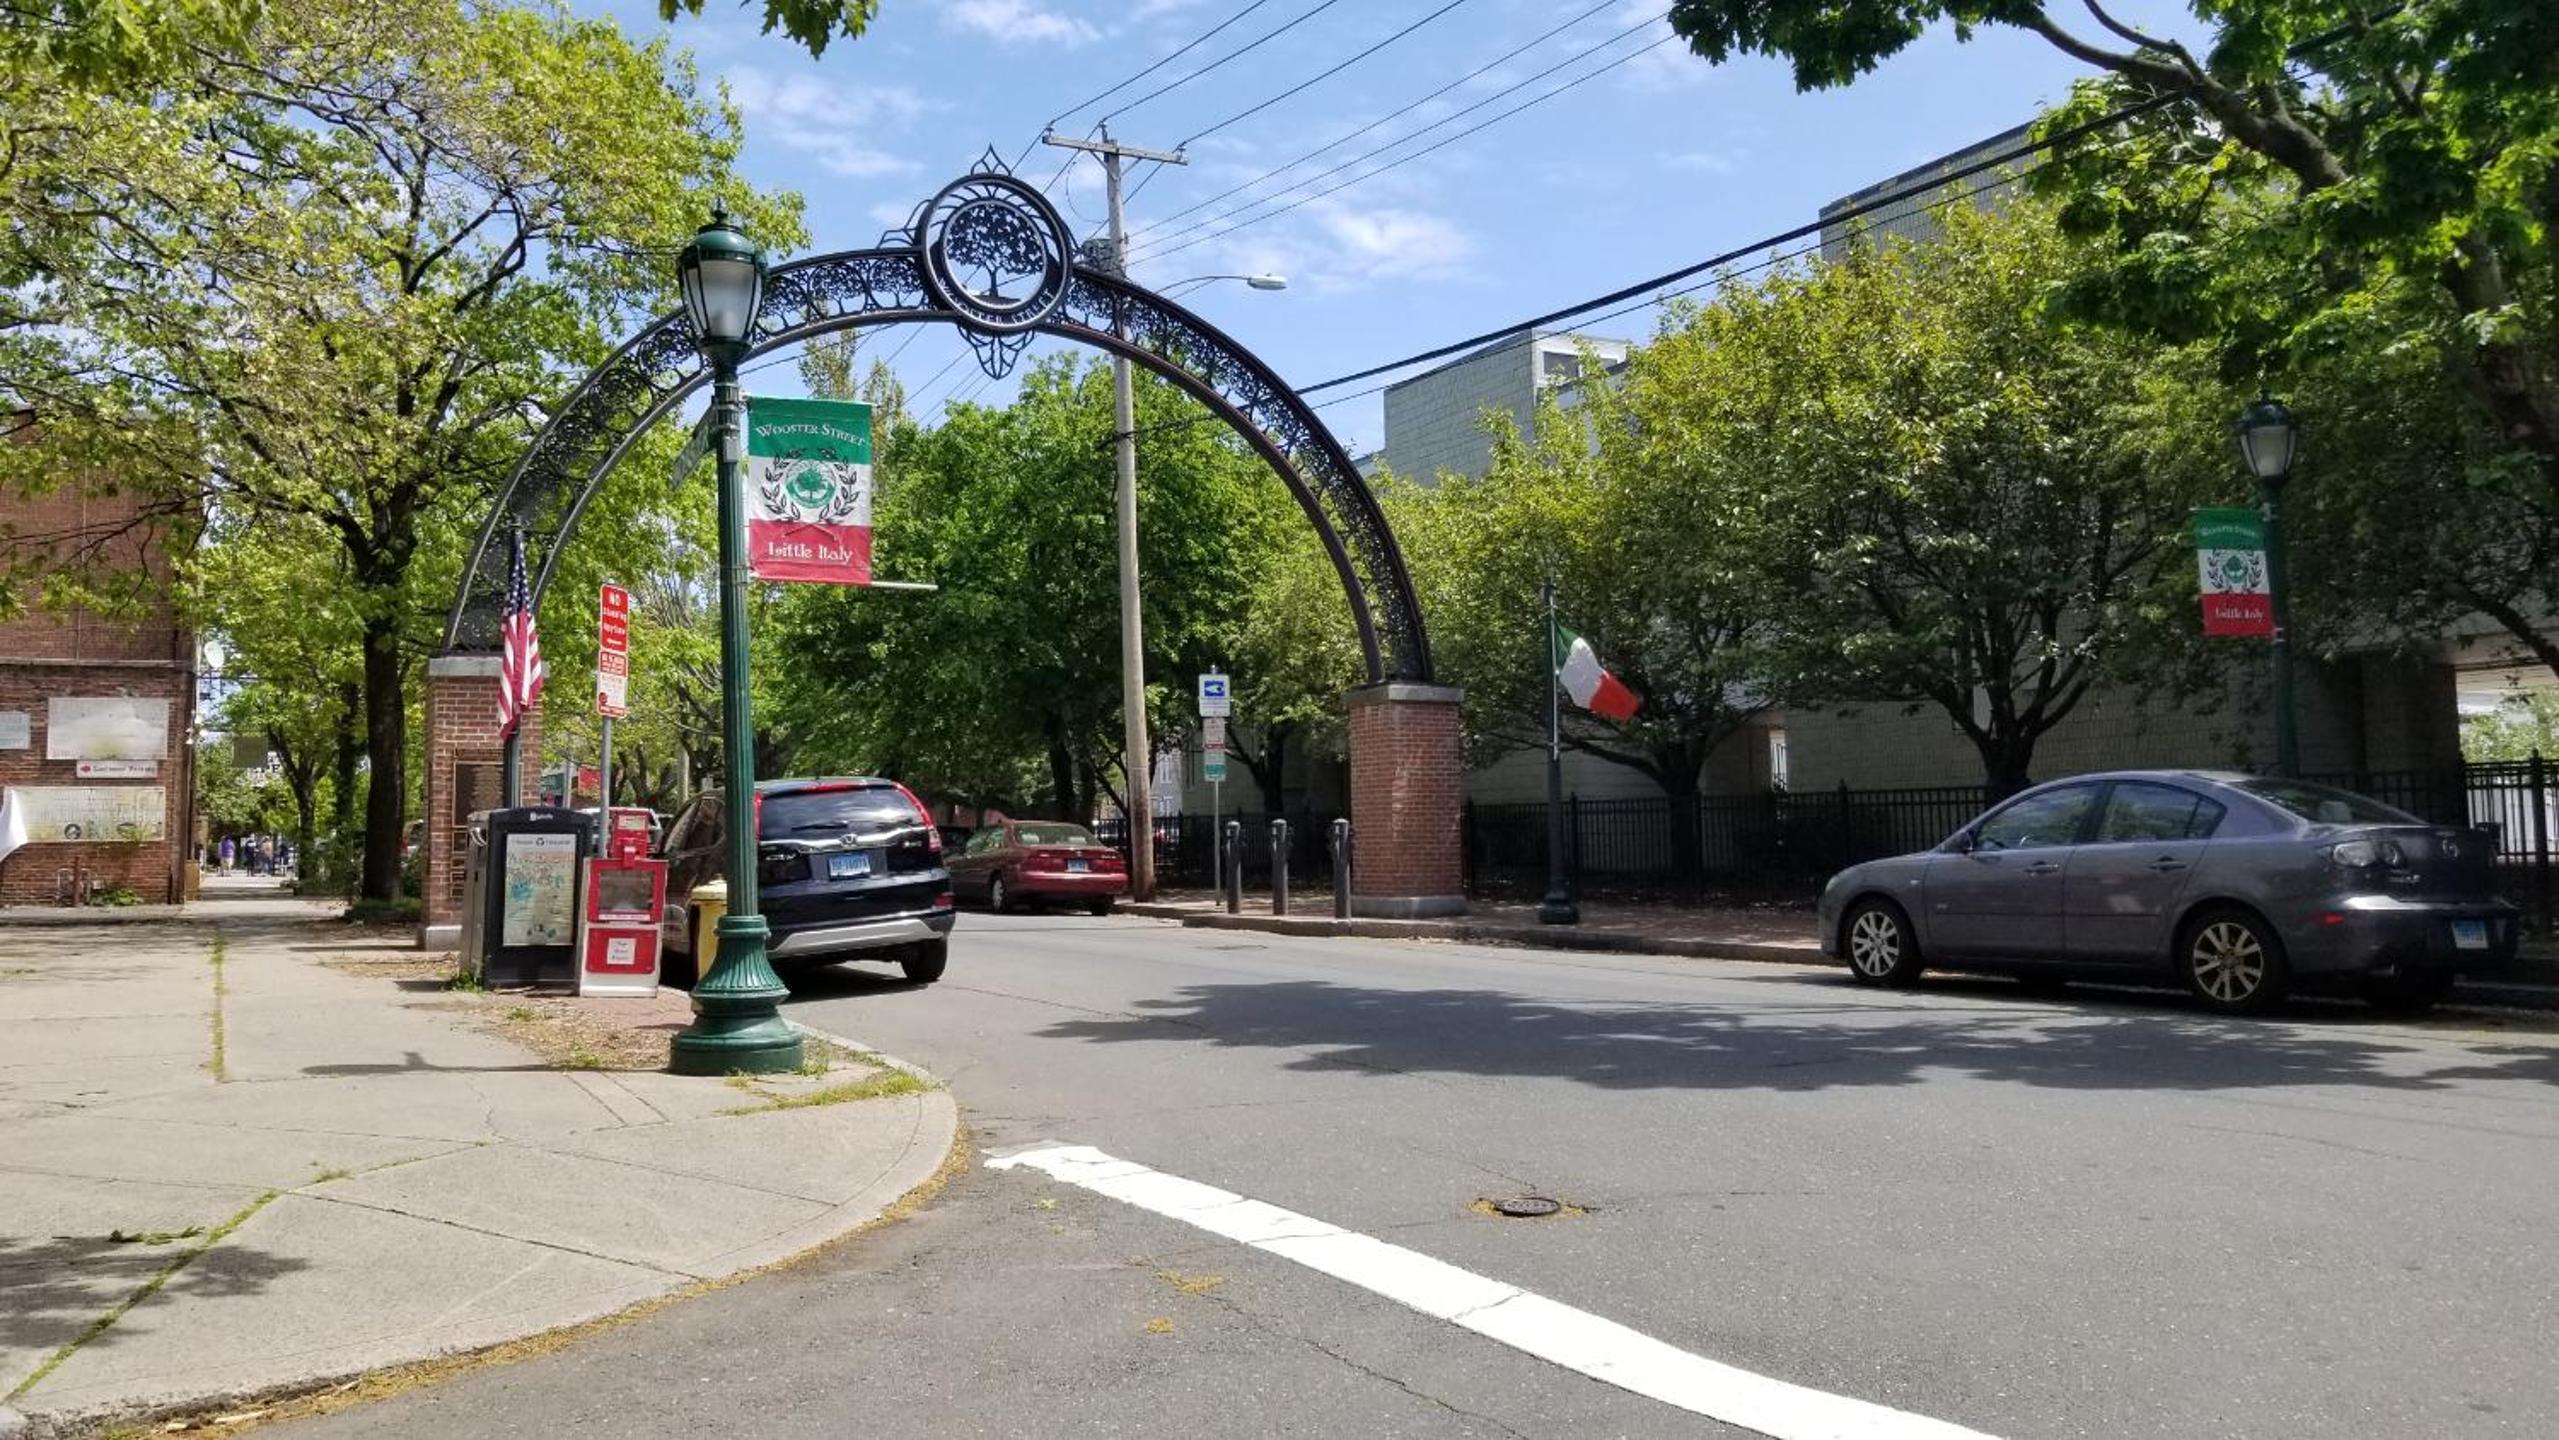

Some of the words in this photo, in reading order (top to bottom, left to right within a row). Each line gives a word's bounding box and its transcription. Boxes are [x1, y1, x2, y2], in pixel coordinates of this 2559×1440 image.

[1011, 288, 1055, 324] STREET
[768, 541, 813, 559] Little
[818, 544, 853, 563] Italy
